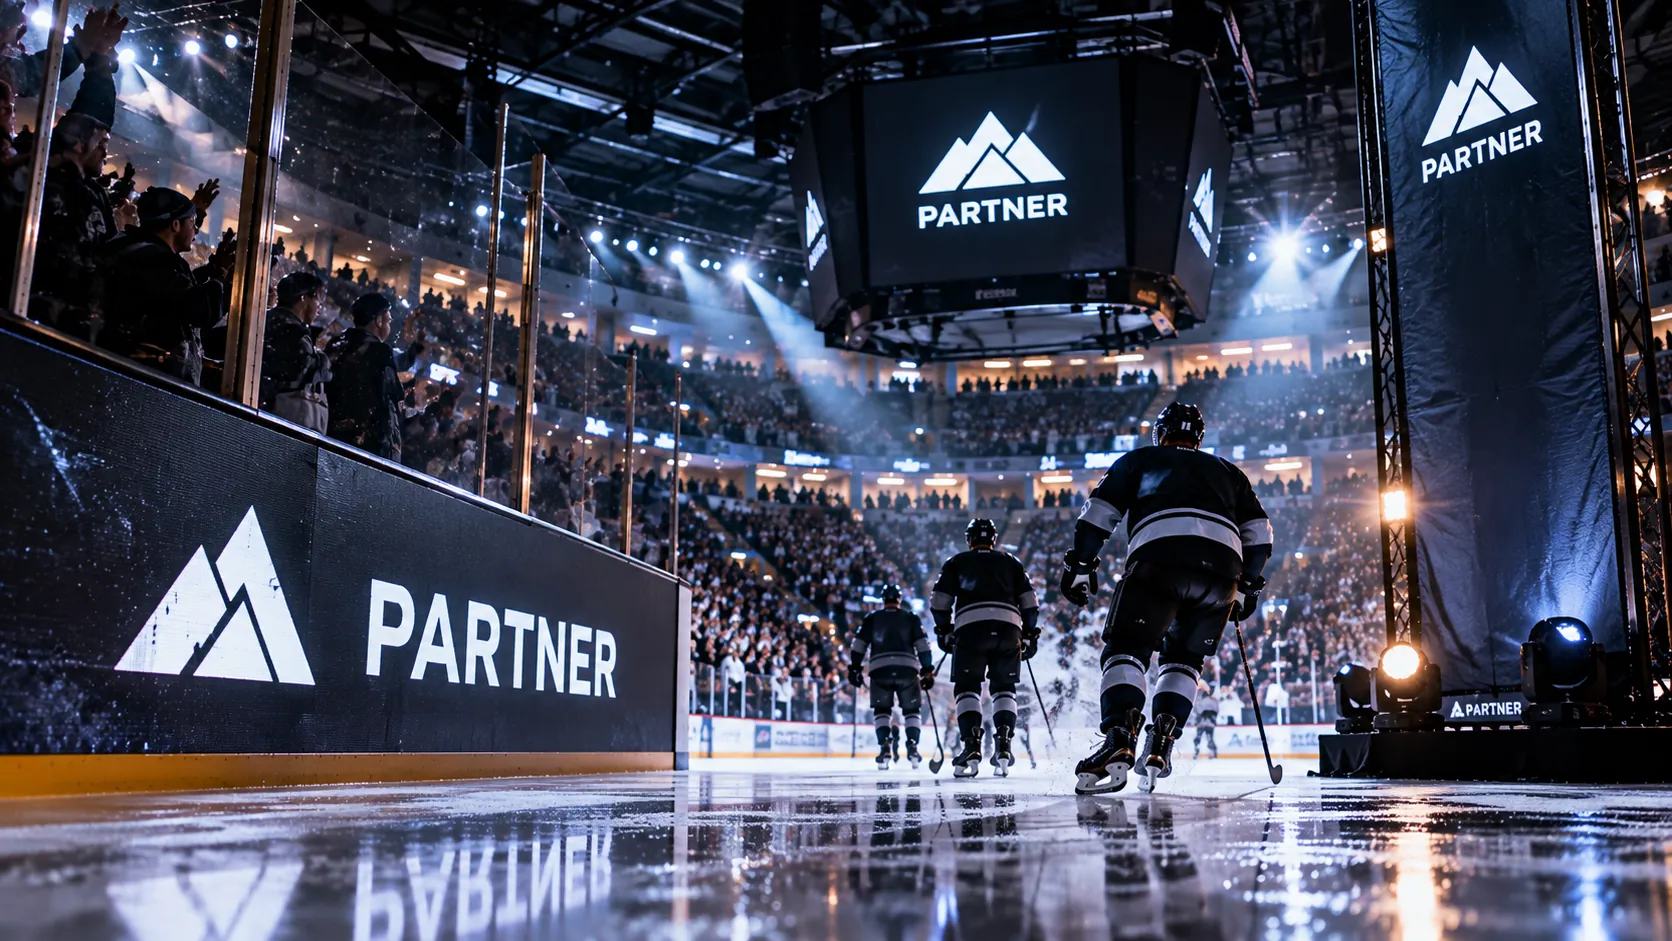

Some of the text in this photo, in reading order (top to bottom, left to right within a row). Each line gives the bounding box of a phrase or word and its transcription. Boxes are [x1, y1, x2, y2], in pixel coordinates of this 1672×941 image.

[1421, 119, 1543, 184] PARTNER
[918, 193, 1068, 229] PARTNER
[365, 578, 617, 699] PARTNER
[1465, 701, 1522, 717] PARTNER
